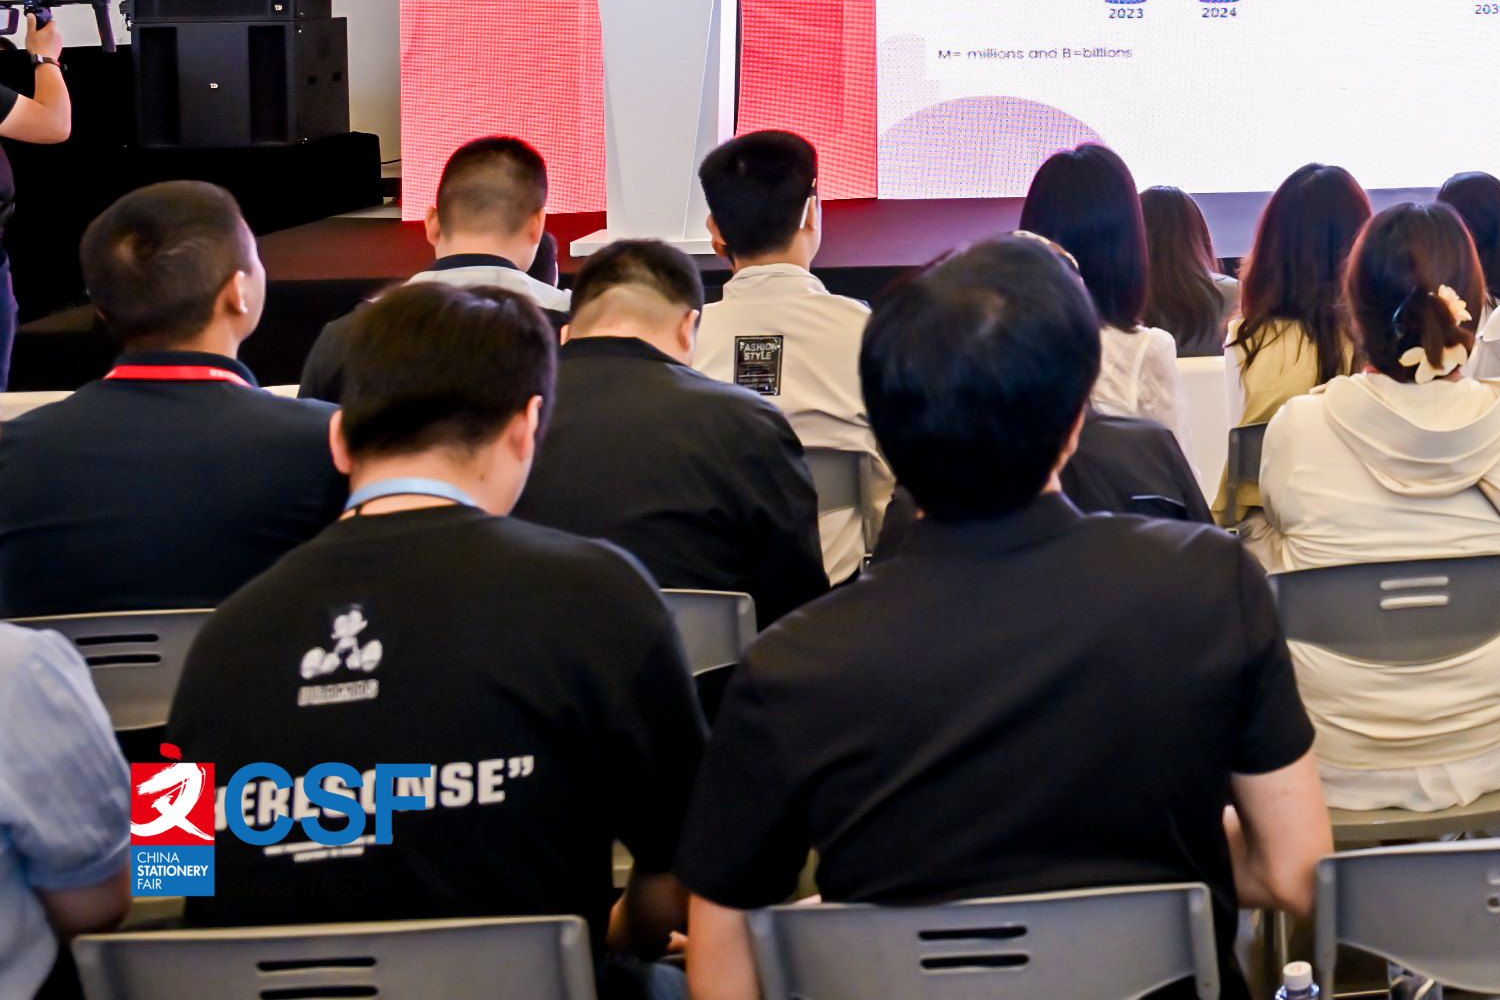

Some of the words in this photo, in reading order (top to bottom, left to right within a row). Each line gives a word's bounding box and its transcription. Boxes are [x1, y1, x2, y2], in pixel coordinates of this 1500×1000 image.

[1108, 7, 1144, 20] 2023
[1201, 7, 1238, 19] 2024
[1028, 47, 1058, 60] and
[743, 351, 772, 361] STYLE
